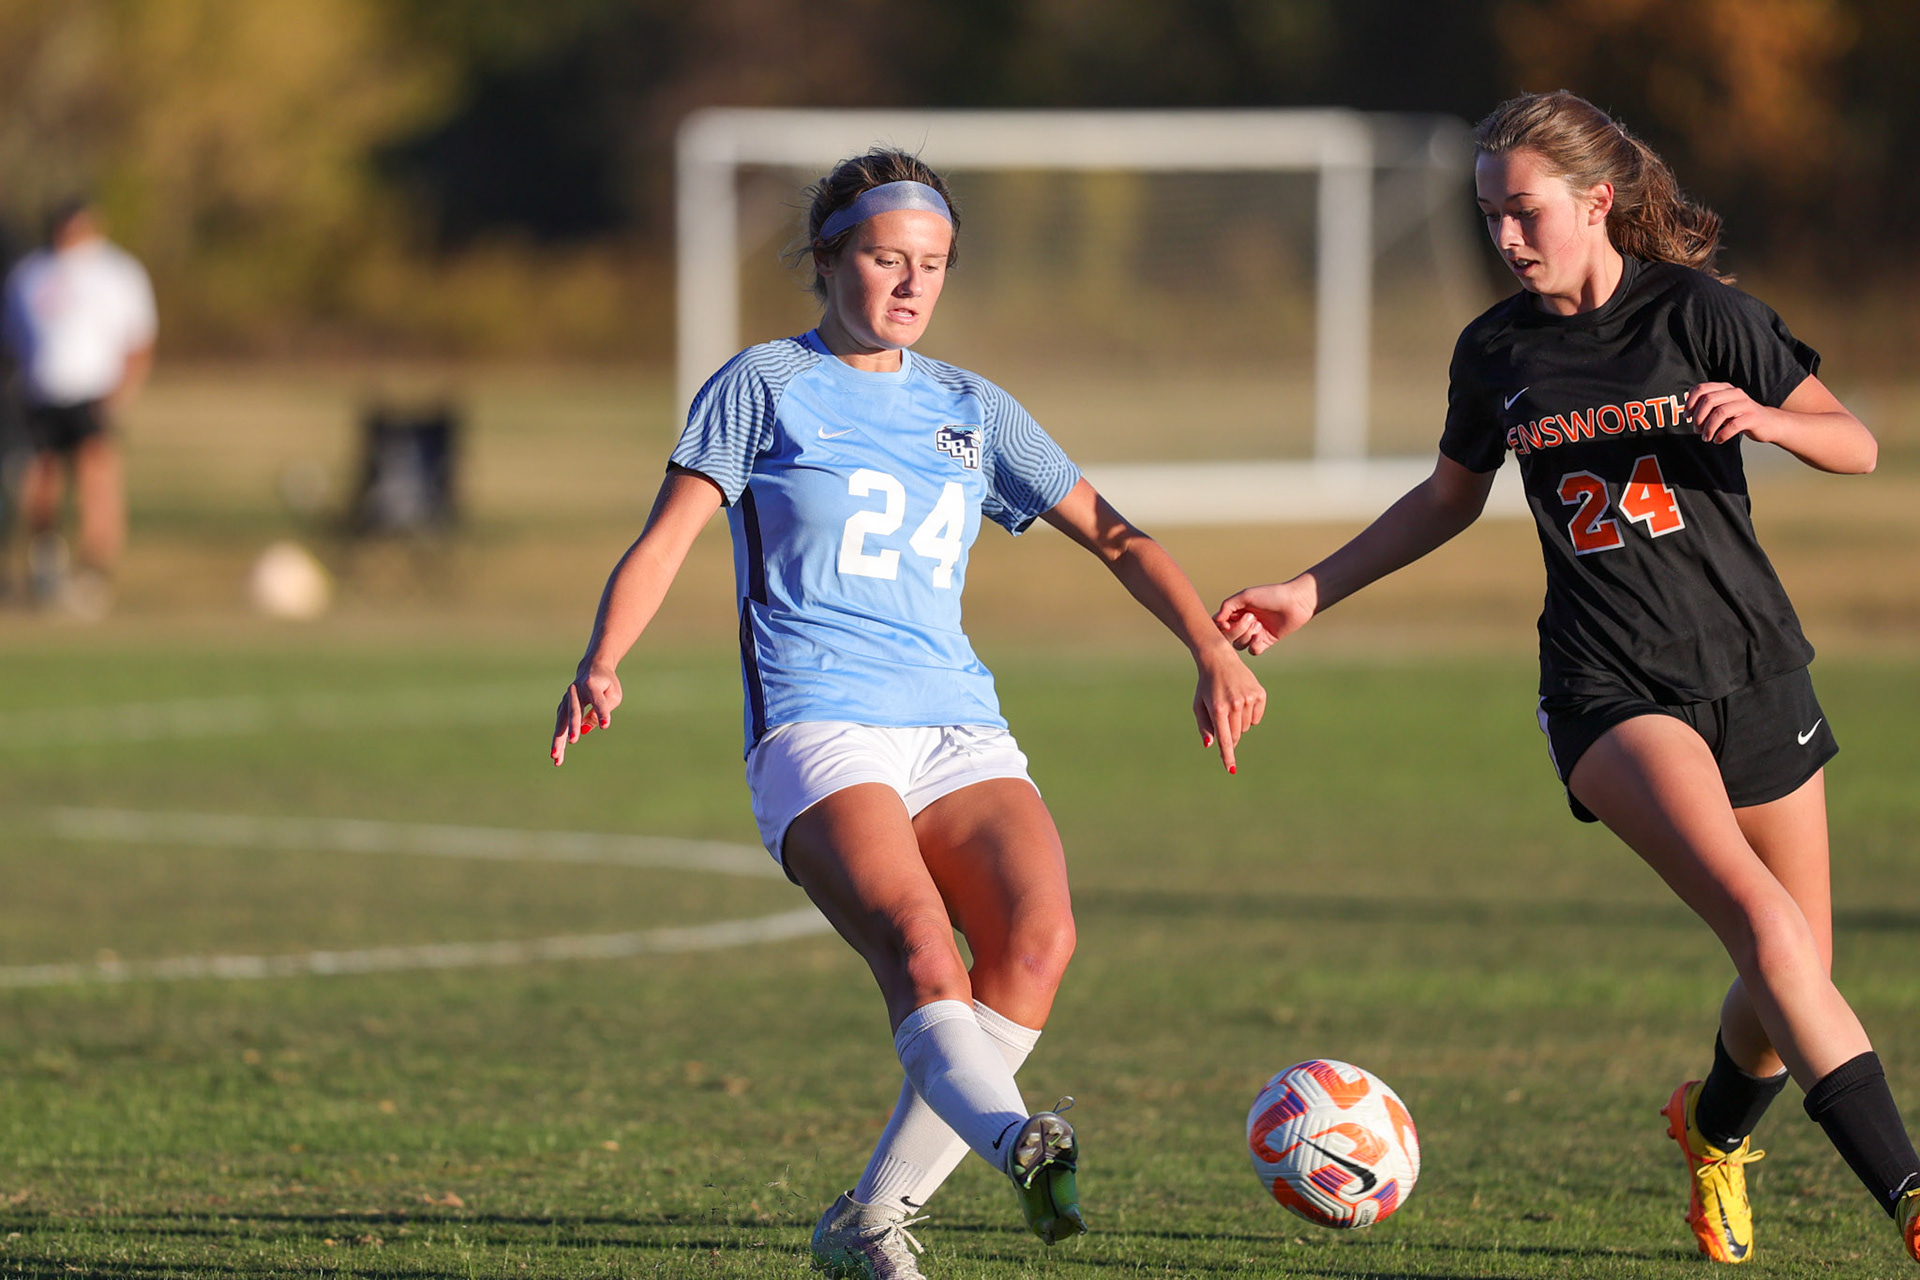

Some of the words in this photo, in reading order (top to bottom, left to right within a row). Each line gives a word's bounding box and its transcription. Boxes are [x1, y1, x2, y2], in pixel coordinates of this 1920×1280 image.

[936, 430, 979, 469] SBA
[1507, 391, 1693, 454] ENSWORTH
[838, 467, 966, 589] 24
[1557, 454, 1686, 556] 24
